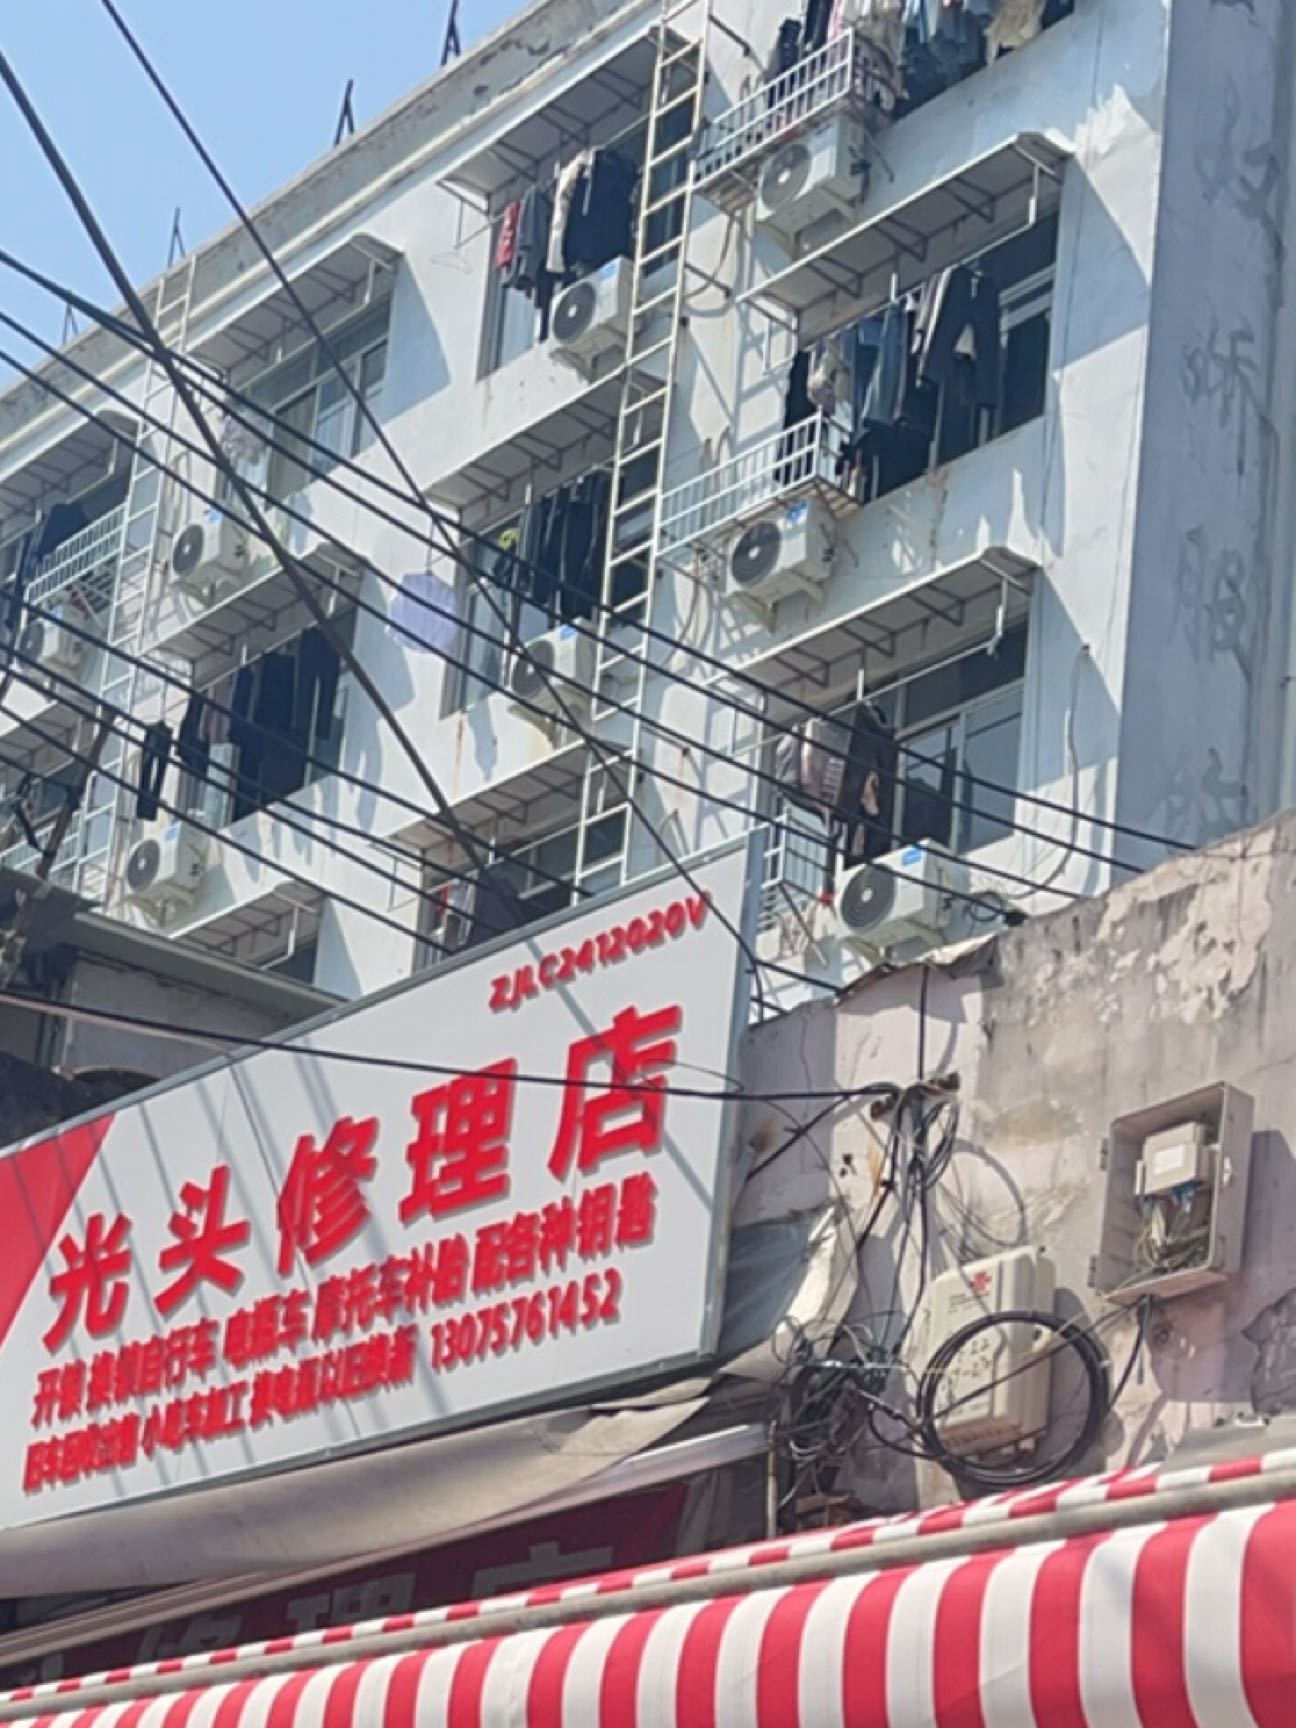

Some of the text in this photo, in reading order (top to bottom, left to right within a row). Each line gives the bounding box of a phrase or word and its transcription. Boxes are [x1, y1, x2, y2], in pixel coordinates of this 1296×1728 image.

[42, 1005, 682, 1353] 光头修理店
[473, 1171, 657, 1295] 配各种钥匙
[431, 1267, 622, 1375] 13075761452
